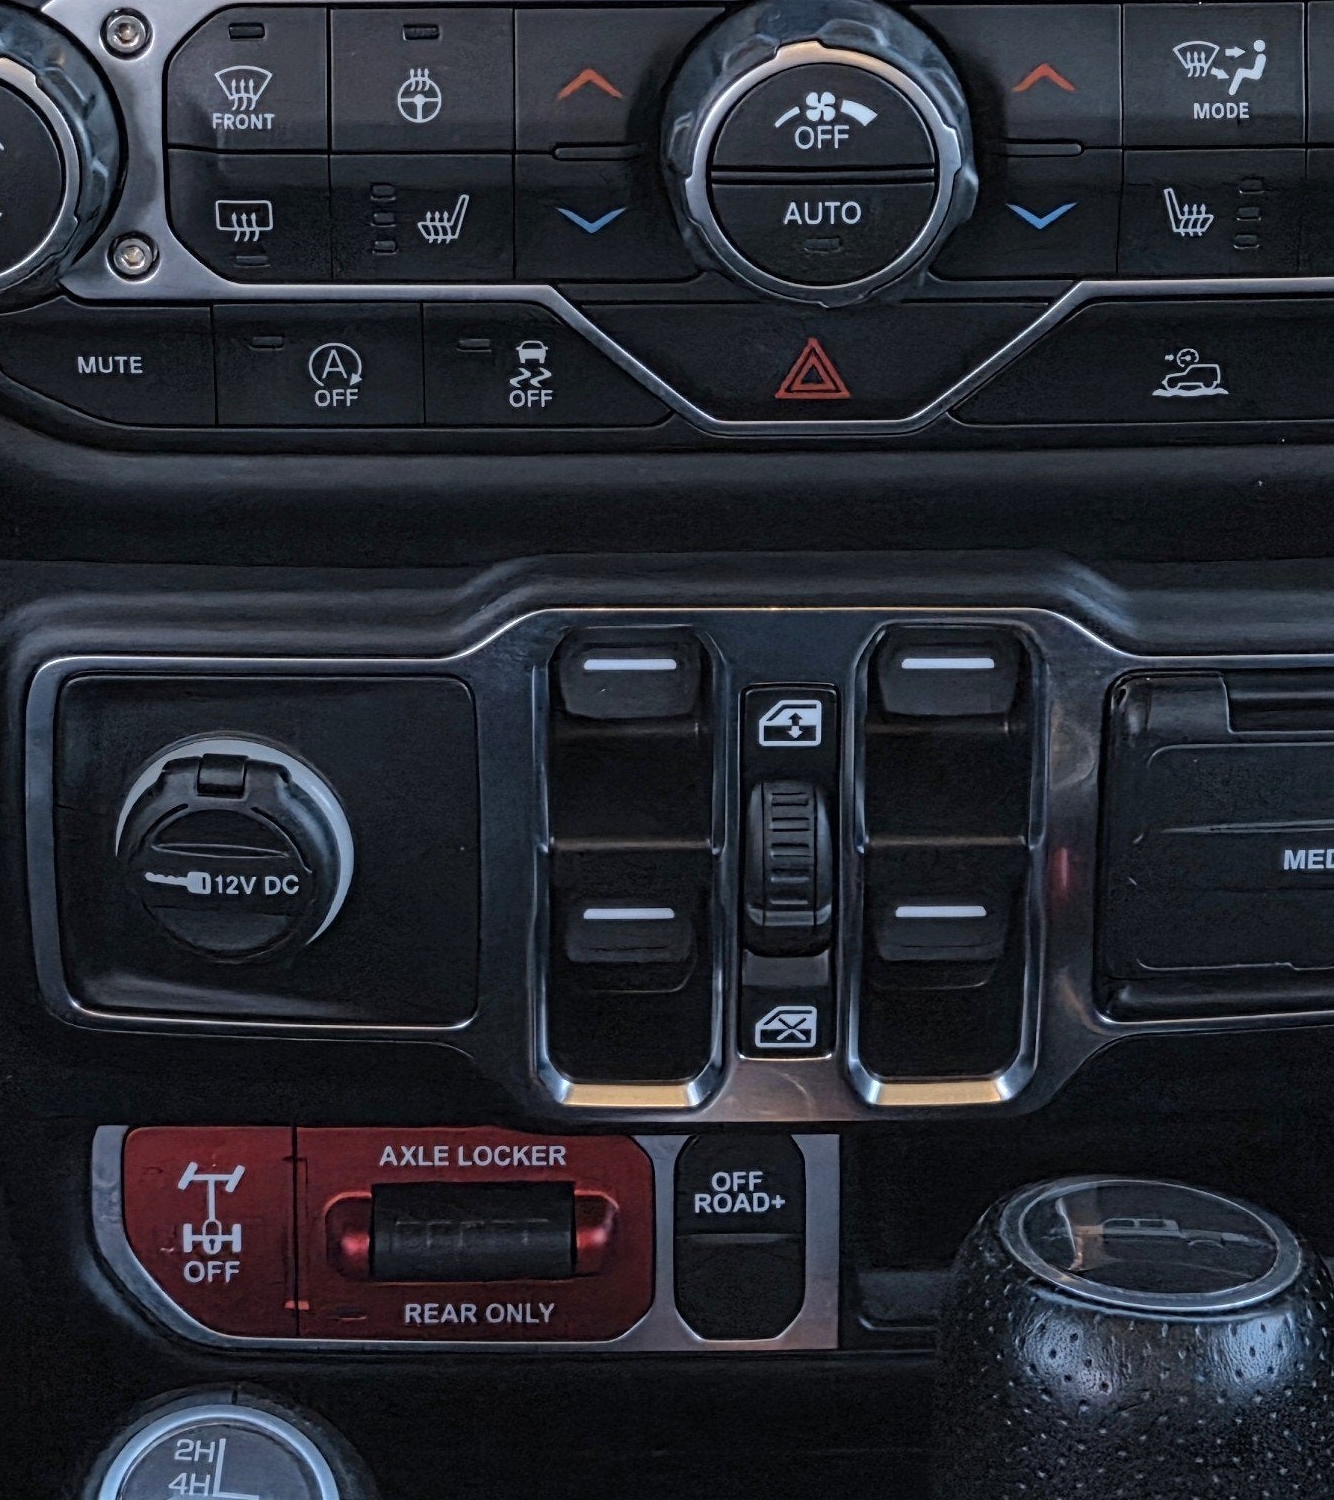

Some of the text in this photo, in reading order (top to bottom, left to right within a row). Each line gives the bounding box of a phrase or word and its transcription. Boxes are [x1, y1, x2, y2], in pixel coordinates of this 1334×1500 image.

[212, 112, 276, 130] FRONT
[1193, 101, 1250, 120] MODE
[794, 124, 850, 150] OFF
[783, 200, 862, 225] AUTO
[77, 356, 143, 374] MUTE
[314, 388, 359, 407] OFF
[508, 389, 554, 408] OFF
[214, 874, 300, 896] 12V DC
[378, 1145, 567, 1167] AXLE LOCKER
[711, 1170, 764, 1192] OFF
[694, 1193, 786, 1214] ROAD+
[183, 1260, 241, 1283] OFF
[404, 1302, 555, 1324] REAR ONLY
[173, 1438, 216, 1463] 2H
[168, 1472, 211, 1496] 4H
